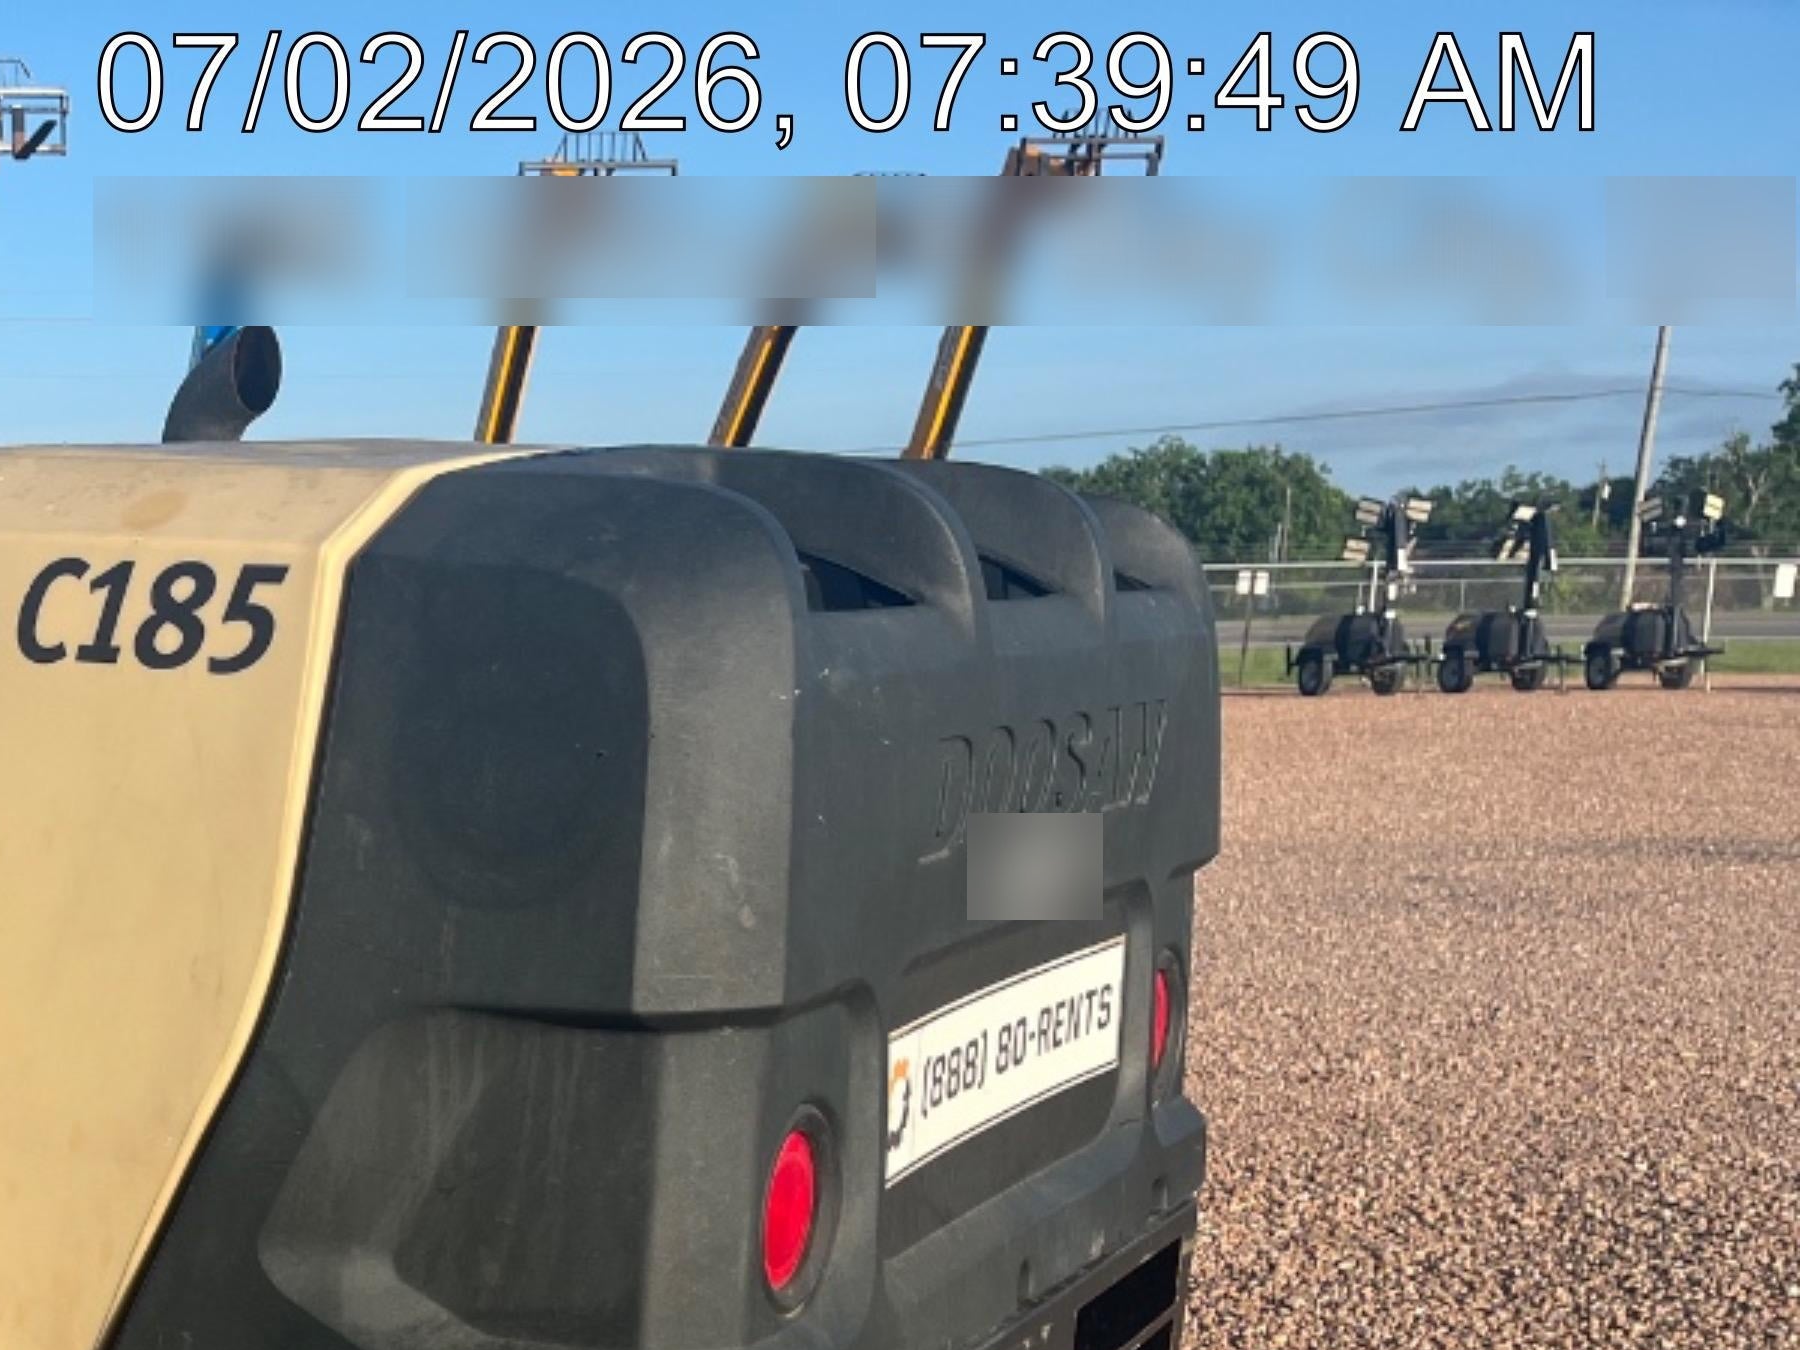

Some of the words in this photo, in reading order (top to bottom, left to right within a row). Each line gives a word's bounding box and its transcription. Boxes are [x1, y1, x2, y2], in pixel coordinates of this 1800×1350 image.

[17, 556, 290, 675] C185
[921, 1028, 988, 1119] (888)
[995, 983, 1112, 1075] 80-RENTS
